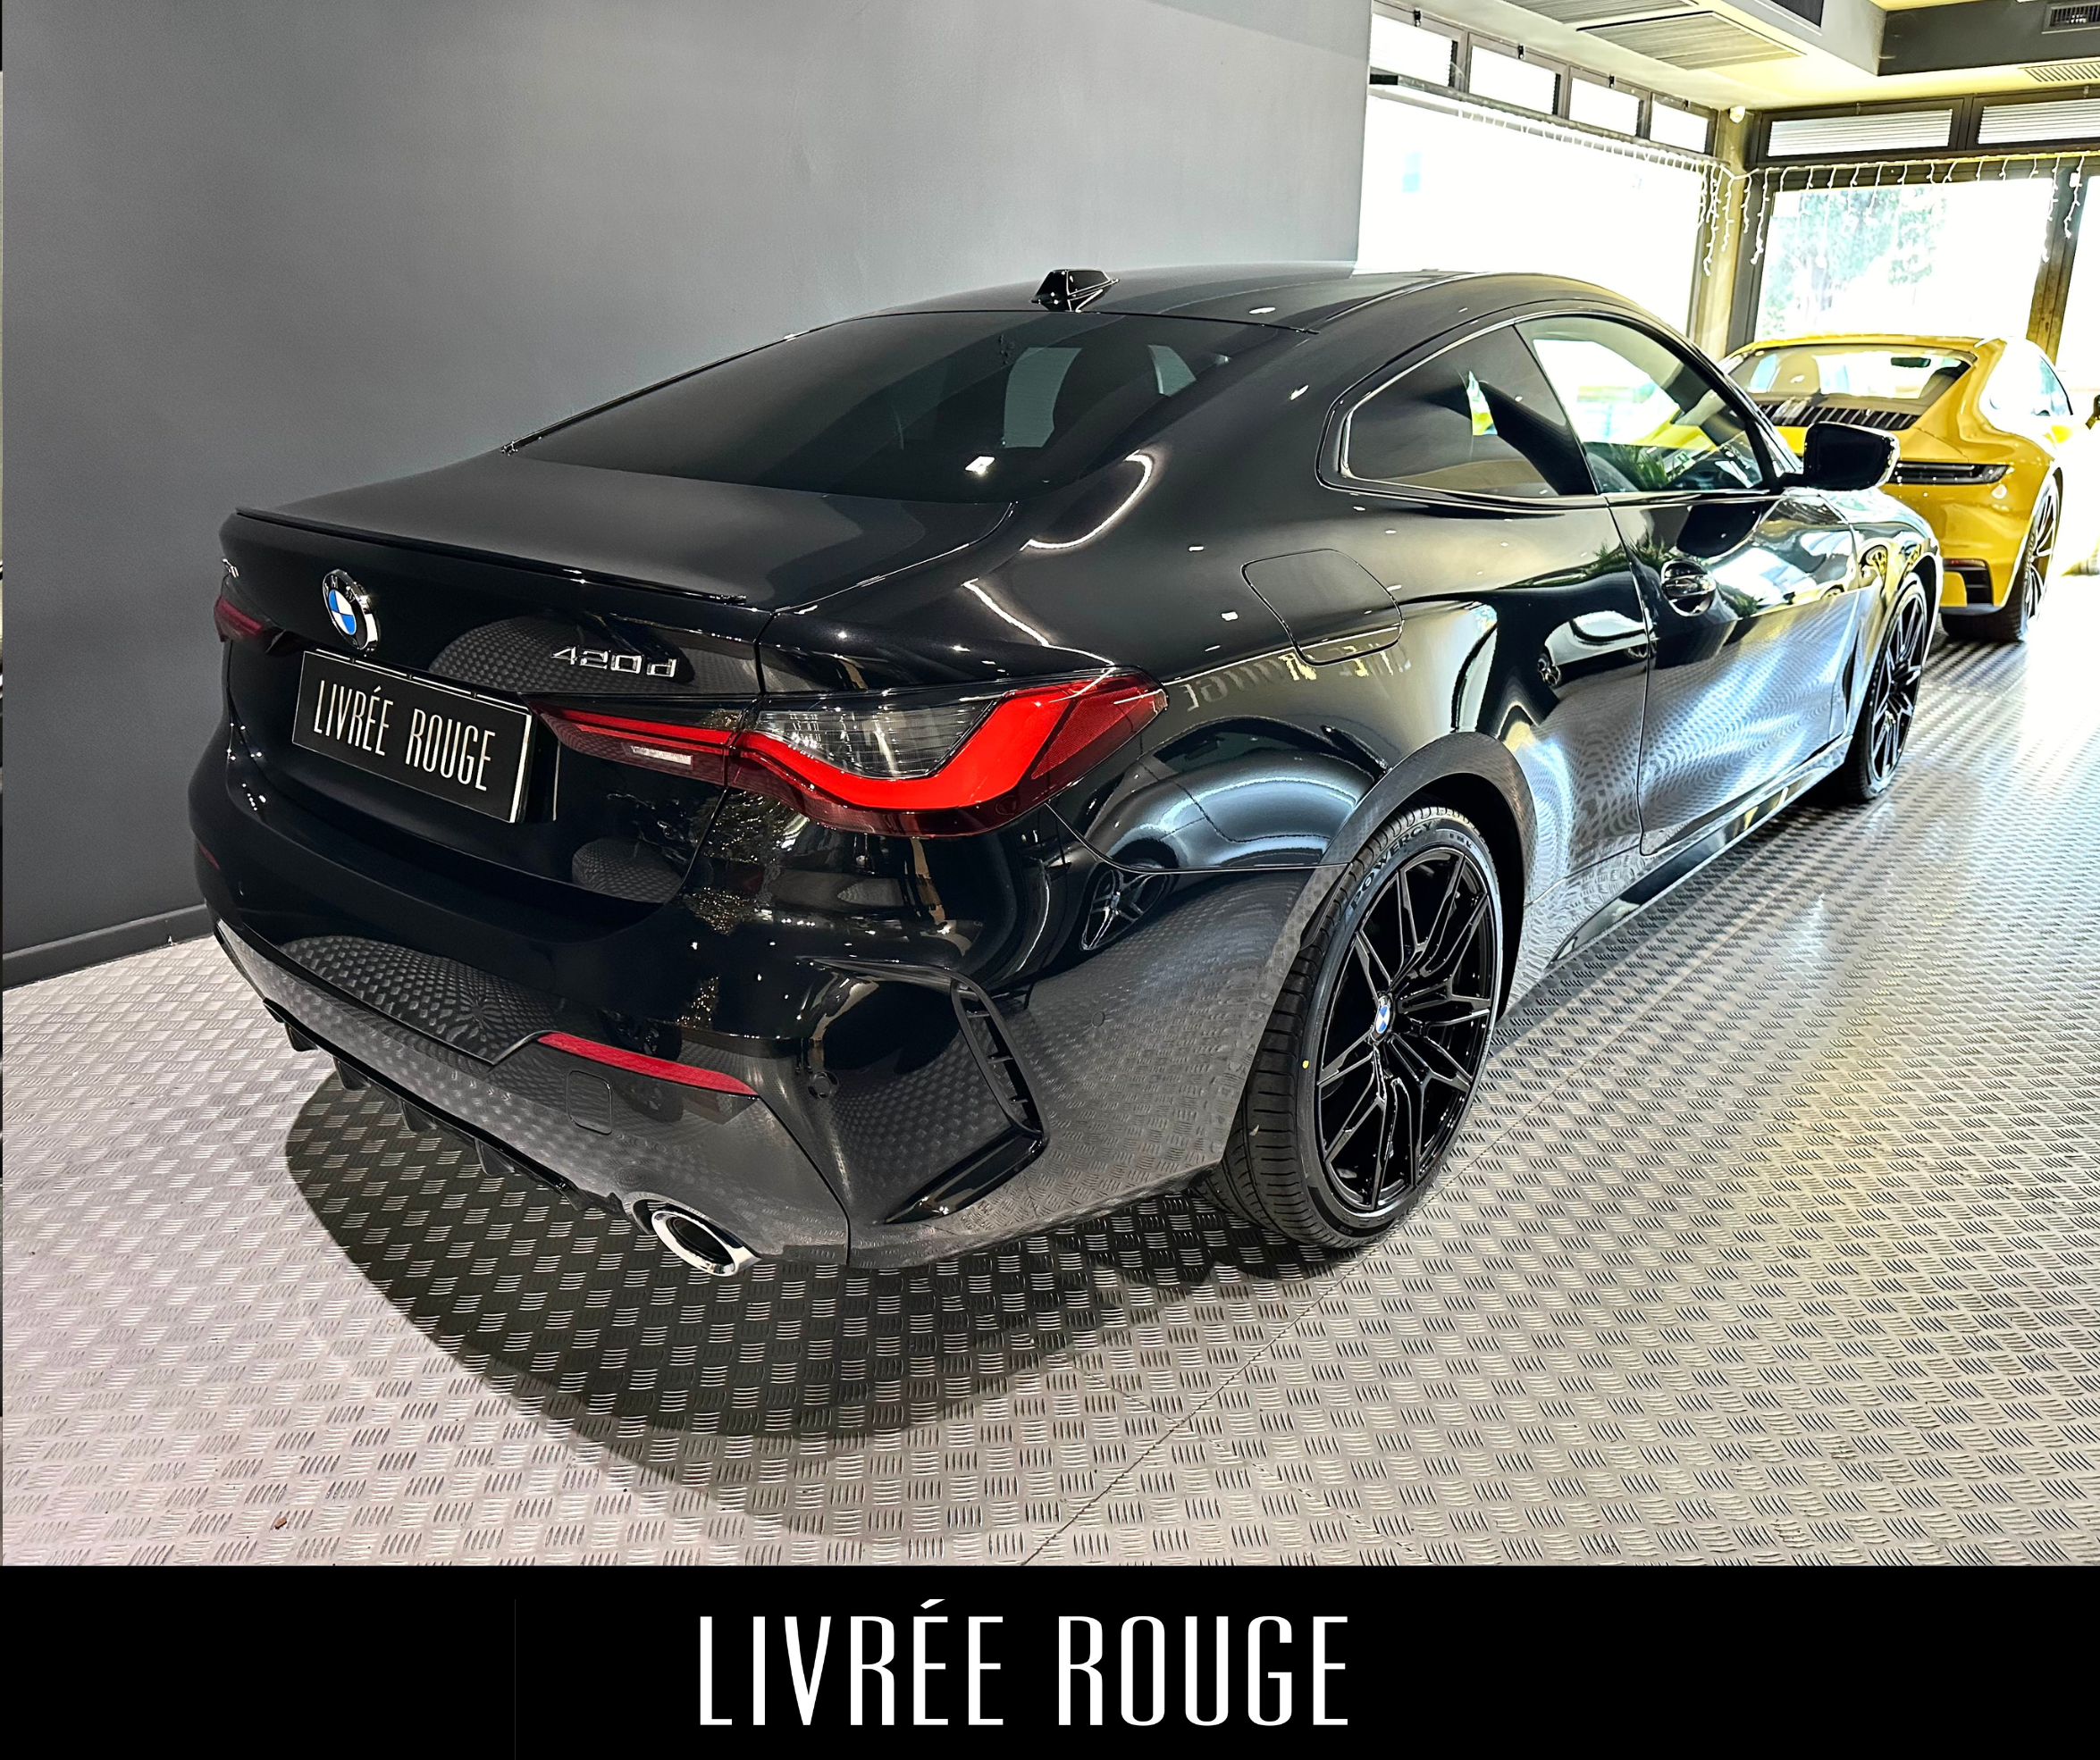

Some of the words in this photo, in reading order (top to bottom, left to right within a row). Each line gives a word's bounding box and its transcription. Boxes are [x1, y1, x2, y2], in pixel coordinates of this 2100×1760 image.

[550, 645, 678, 678] 420d
[314, 679, 394, 758] LIVRÉE
[405, 708, 496, 792] ROUGE
[1350, 822, 1432, 910] POWERGY
